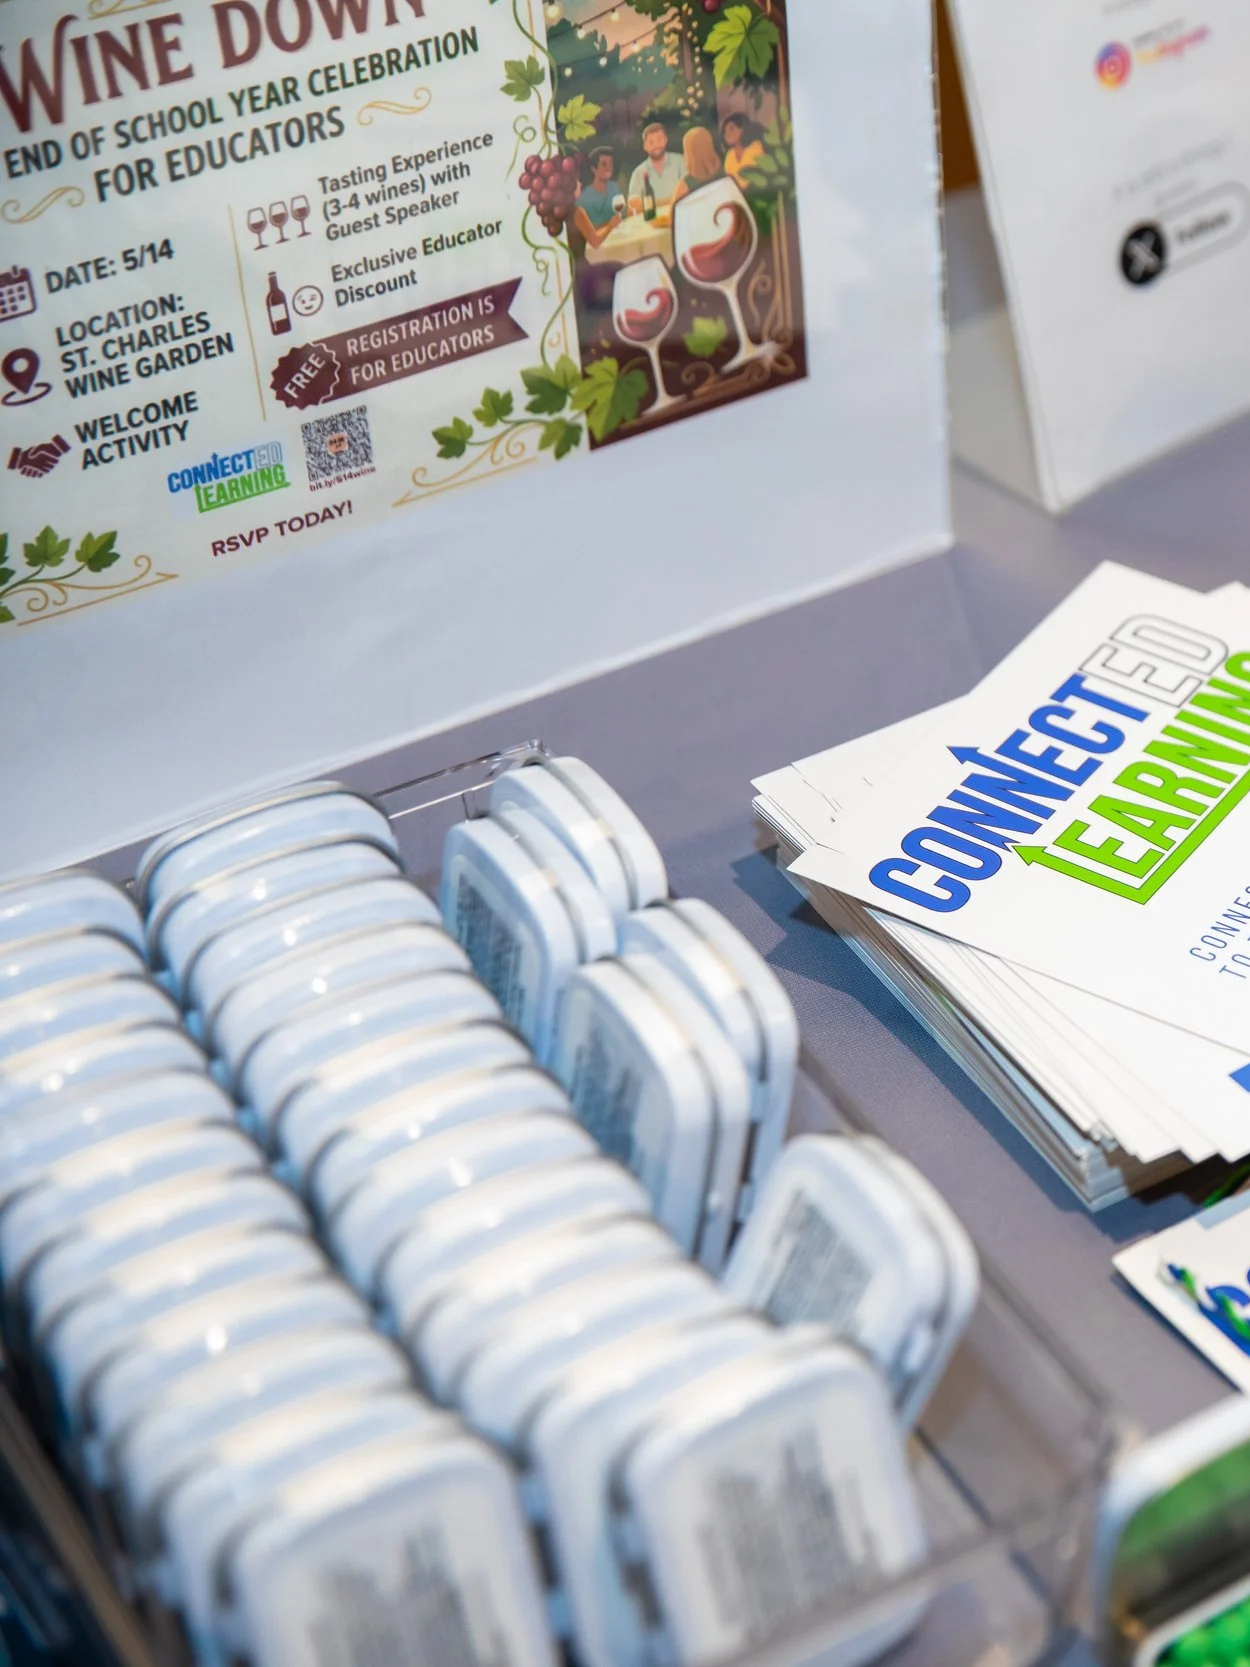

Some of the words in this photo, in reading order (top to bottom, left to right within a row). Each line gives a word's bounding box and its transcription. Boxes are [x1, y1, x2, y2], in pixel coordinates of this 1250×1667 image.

[0, 14, 194, 133] WINE
[3, 138, 63, 179] END
[70, 125, 106, 161] OF
[113, 97, 224, 149] SCHOOL
[228, 76, 302, 117] YEAR
[307, 25, 480, 97] CELEBRATION
[94, 157, 159, 203] FOR
[165, 106, 346, 183] EDUCATORS
[317, 166, 387, 195] Tasting
[391, 132, 494, 174] Experience
[322, 198, 361, 222] (3-4
[364, 174, 426, 208] wines)
[430, 161, 471, 186] with
[326, 212, 381, 241] Guest
[385, 190, 460, 225] Speaker
[45, 257, 117, 294] DATE:
[121, 238, 175, 271] 5/14
[331, 246, 418, 283] Exclusive
[421, 219, 503, 256] Educator
[334, 269, 418, 308] Discount
[55, 293, 185, 347] LOCATION:
[60, 346, 97, 373] ST.
[101, 311, 211, 360] CHARLES
[346, 303, 474, 356] REGISTRATION
[478, 295, 495, 316] IS
[64, 362, 131, 399] WINE
[135, 332, 235, 379] GARDEN
[284, 352, 326, 399] FREE
[350, 358, 386, 385] FOR
[391, 324, 495, 374] EDUCATORS
[74, 390, 200, 444] WELCOME
[81, 419, 190, 471] ACTIVITY
[167, 441, 283, 493] CONNECTED
[194, 464, 287, 513] LEARNING
[211, 526, 269, 557] RSVP
[274, 500, 353, 536] TODAY!
[868, 613, 1229, 913] CONNECTED
